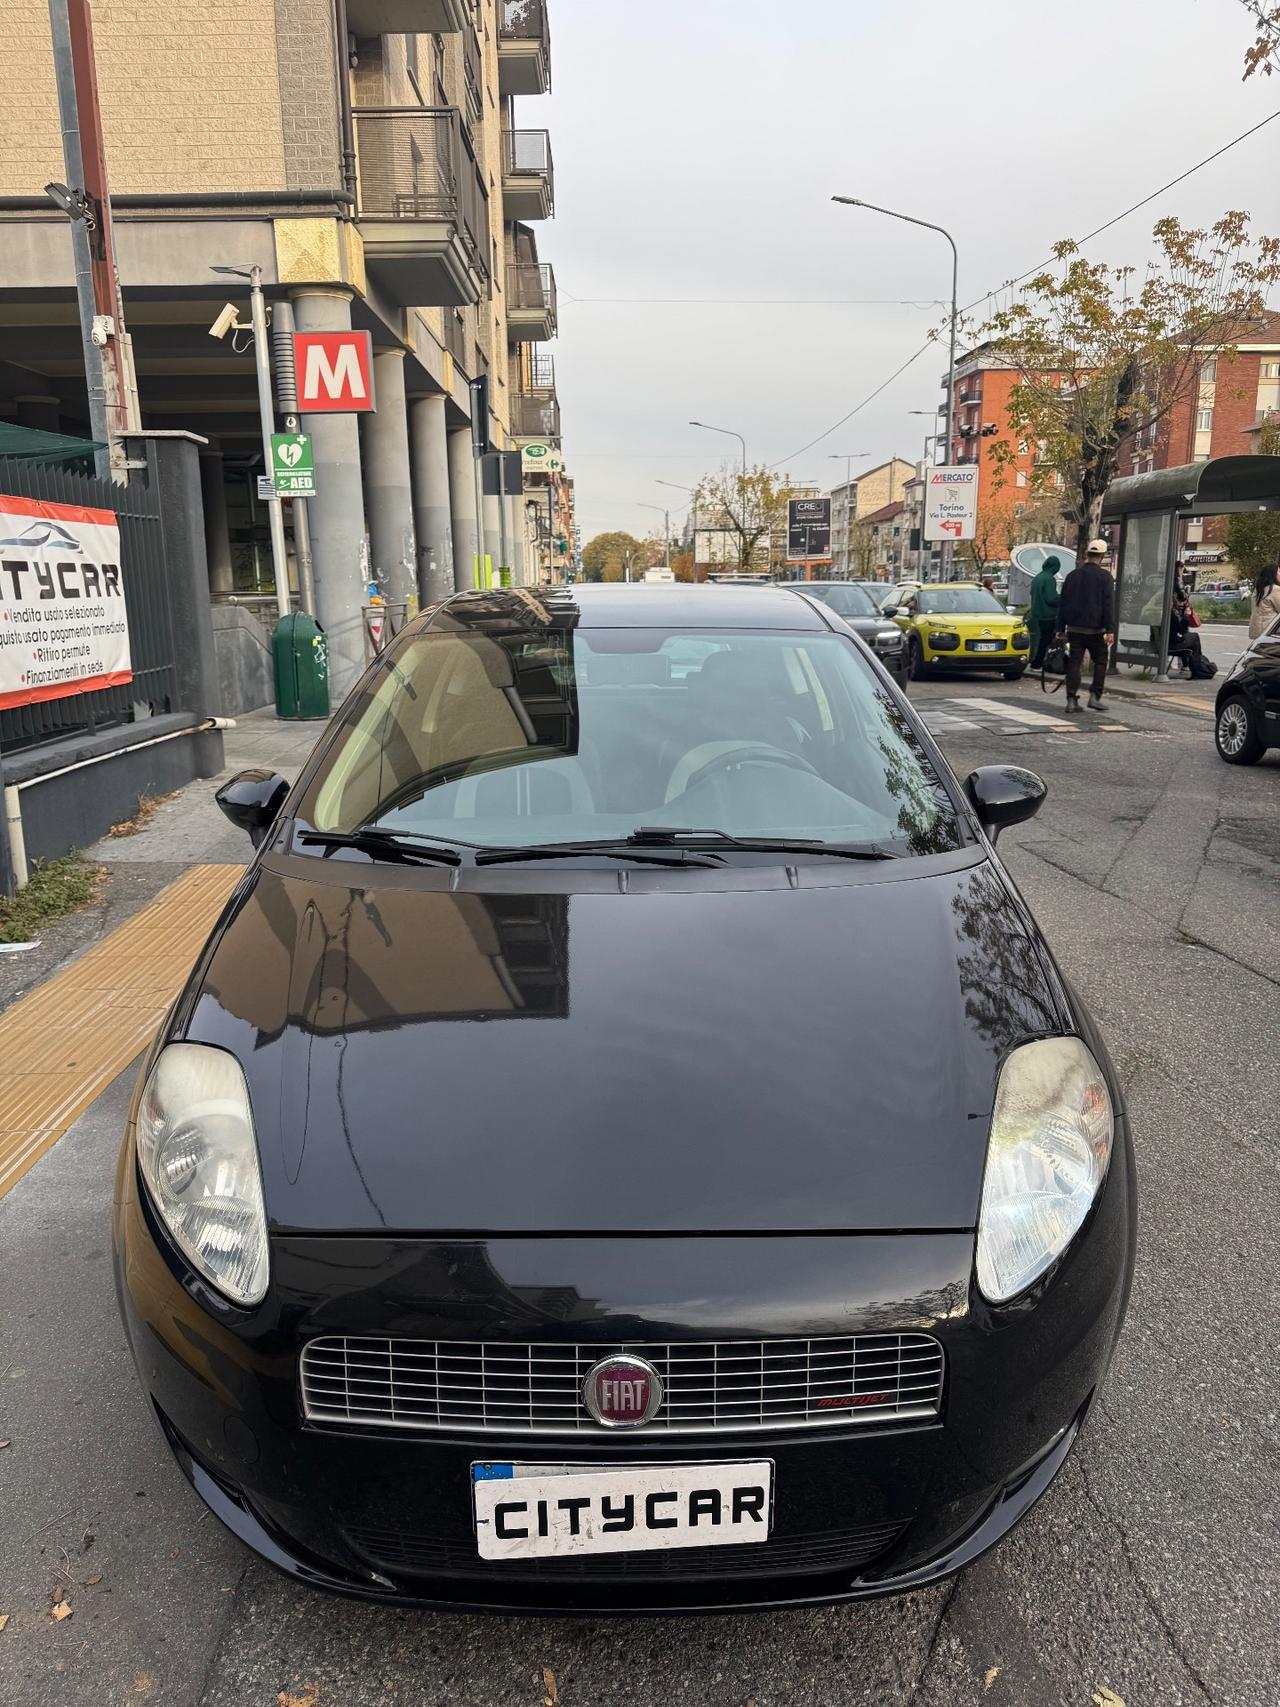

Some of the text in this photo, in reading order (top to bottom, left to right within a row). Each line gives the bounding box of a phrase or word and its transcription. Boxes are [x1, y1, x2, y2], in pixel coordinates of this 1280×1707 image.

[303, 344, 366, 399] M
[290, 477, 312, 489] AED
[939, 503, 965, 511] Torino
[9, 604, 105, 622] Vendita usato selezionato
[22, 627, 48, 643] usato
[50, 624, 91, 643] pagamento
[92, 621, 125, 636] immediato
[37, 643, 91, 662] Ritiro permute
[26, 659, 104, 684] Finanziamenti in sede
[602, 1380, 646, 1411] FIAT
[816, 1394, 888, 1408] MULTIJET
[494, 1485, 765, 1540] CITYCAR
